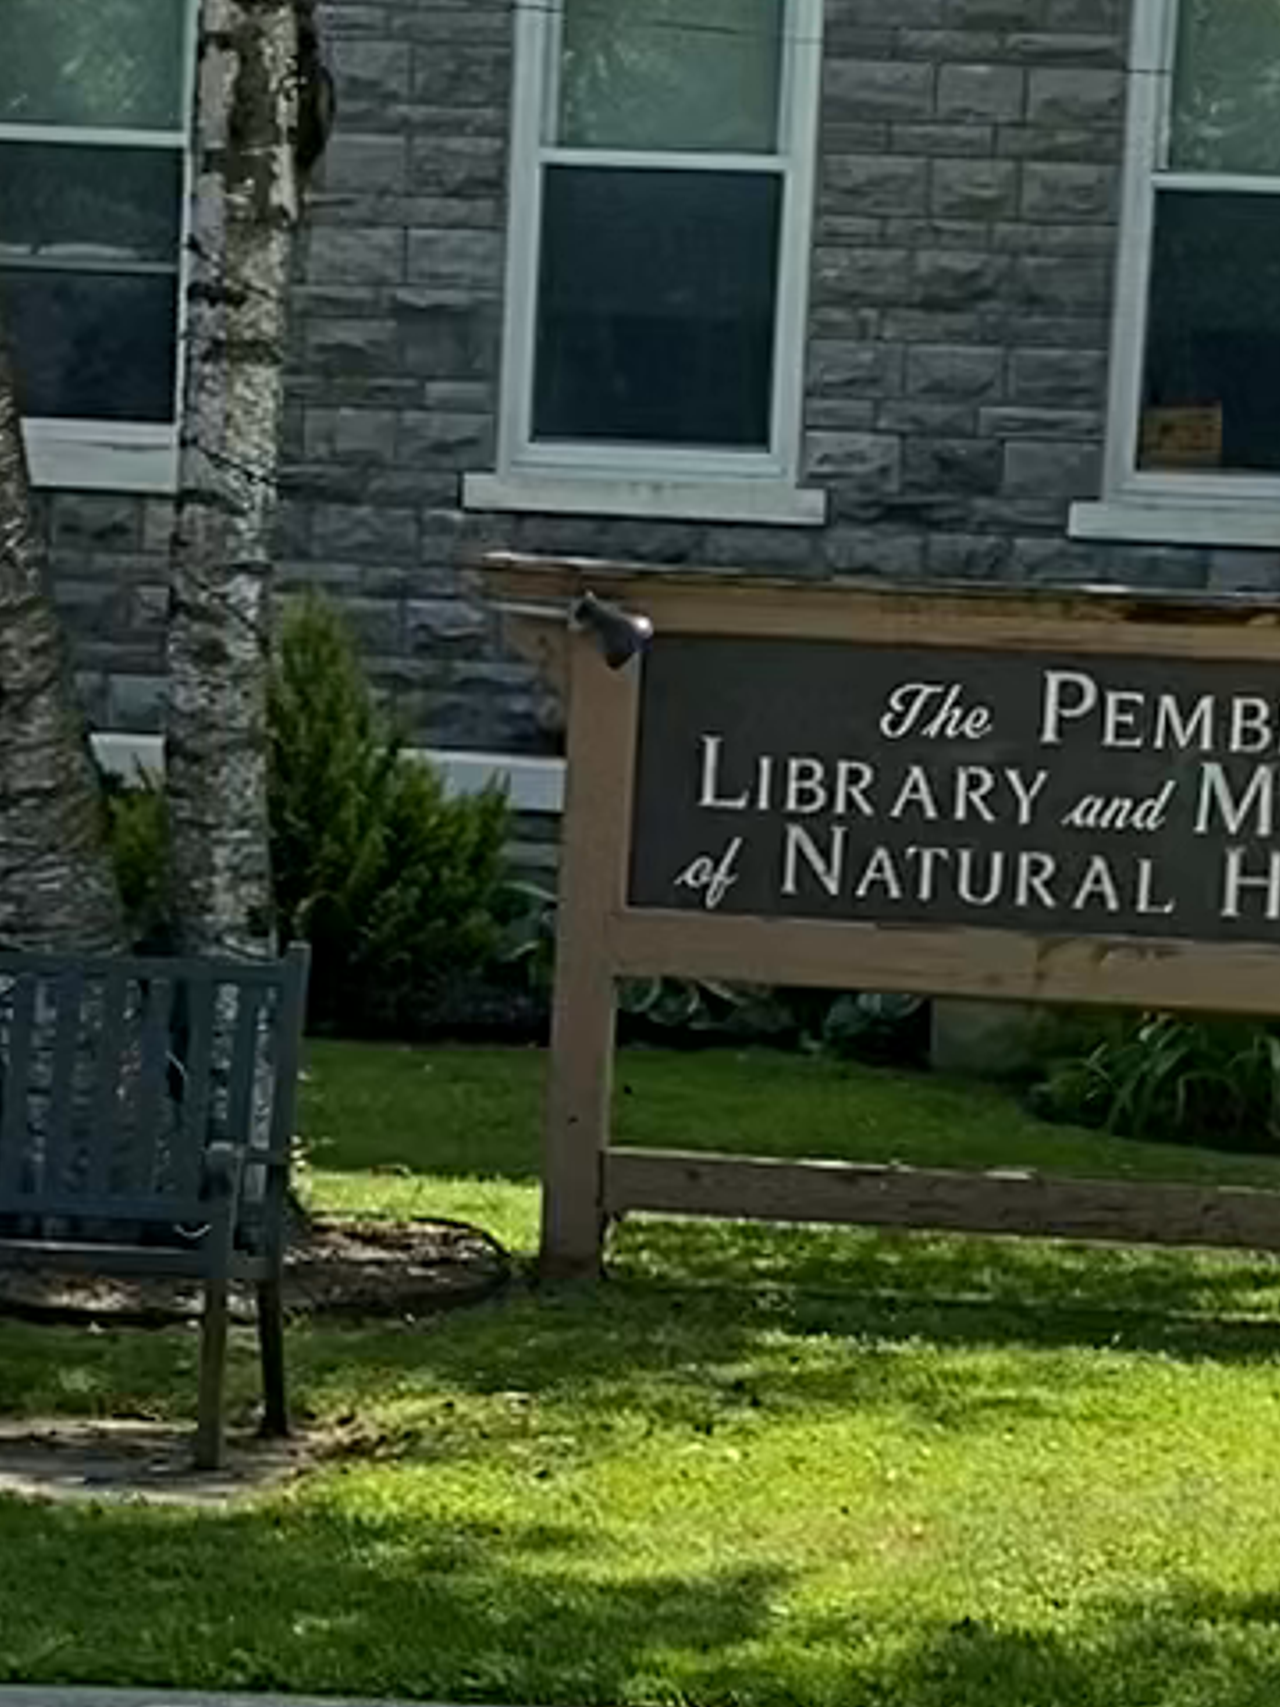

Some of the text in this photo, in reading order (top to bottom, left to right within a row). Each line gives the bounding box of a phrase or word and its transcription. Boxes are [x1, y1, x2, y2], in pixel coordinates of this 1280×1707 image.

[880, 683, 992, 739] The
[698, 735, 1048, 827] LIBRARY
[1061, 780, 1176, 833] and
[674, 836, 744, 910] of
[781, 822, 1175, 917] NATURAL
